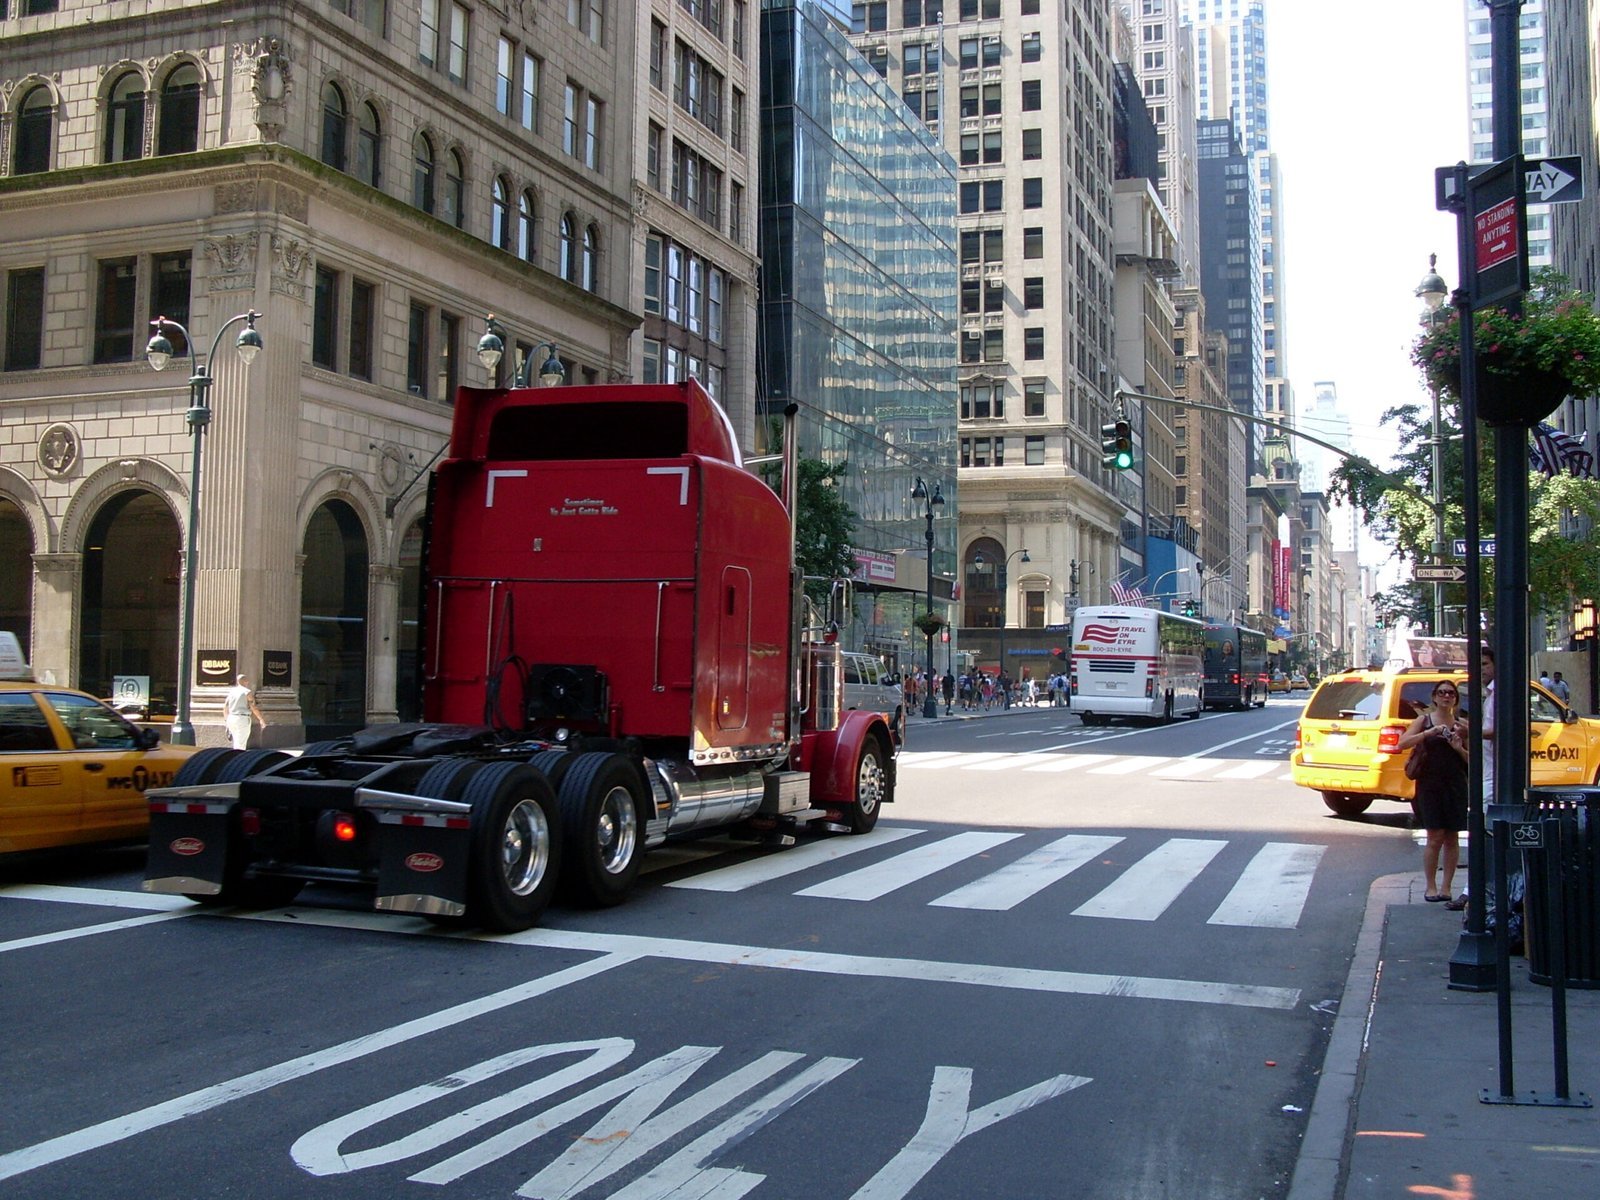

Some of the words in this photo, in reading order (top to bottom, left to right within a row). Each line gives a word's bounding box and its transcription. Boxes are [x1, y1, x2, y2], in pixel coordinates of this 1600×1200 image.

[1477, 218, 1485, 230] NO
[1487, 203, 1515, 226] STANDING
[1482, 221, 1511, 245] ANYTIME
[1547, 744, 1579, 761] TAXI
[290, 1037, 1093, 1200] ONLY
